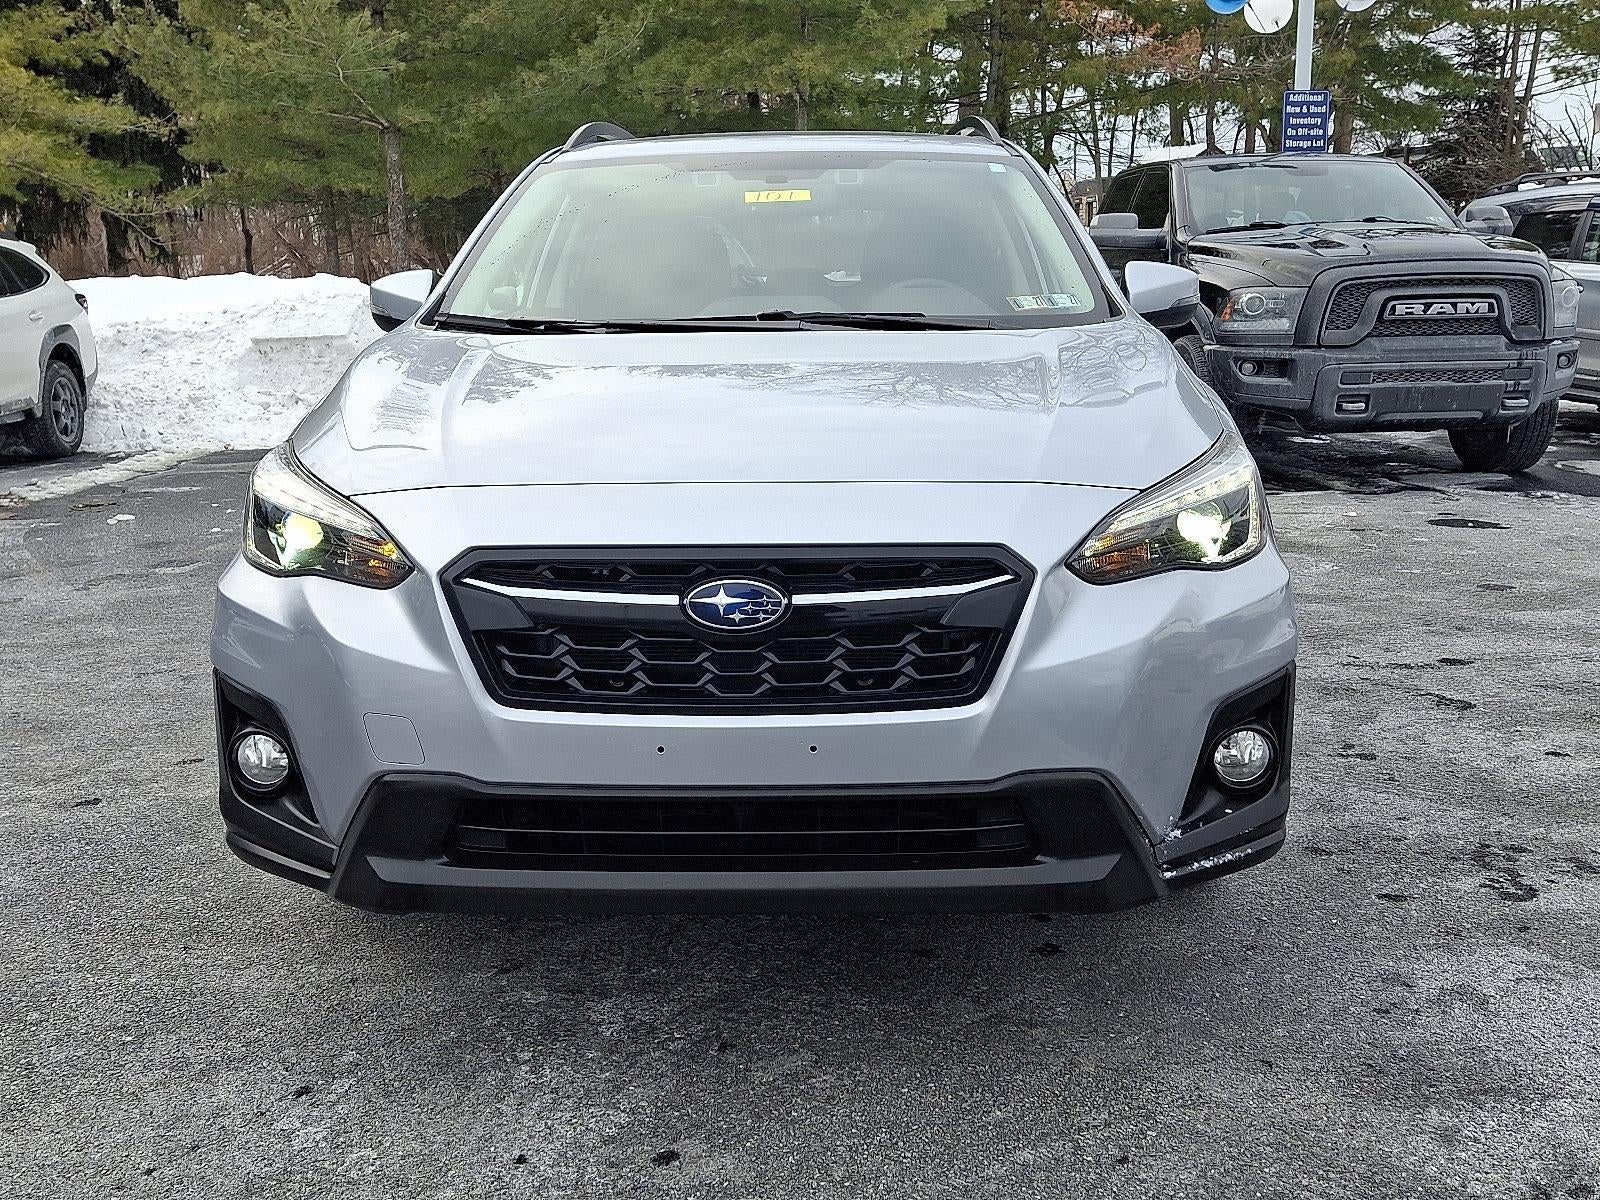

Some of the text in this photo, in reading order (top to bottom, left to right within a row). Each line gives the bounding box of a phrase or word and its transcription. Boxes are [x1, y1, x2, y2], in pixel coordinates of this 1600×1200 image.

[1289, 93, 1324, 102] Additional
[1286, 104, 1326, 113] New & Used
[1289, 116, 1322, 126] Inventory
[1286, 127, 1324, 136] On Off-site
[1285, 139, 1324, 149] Storage Lot
[1395, 302, 1489, 316] RAM
